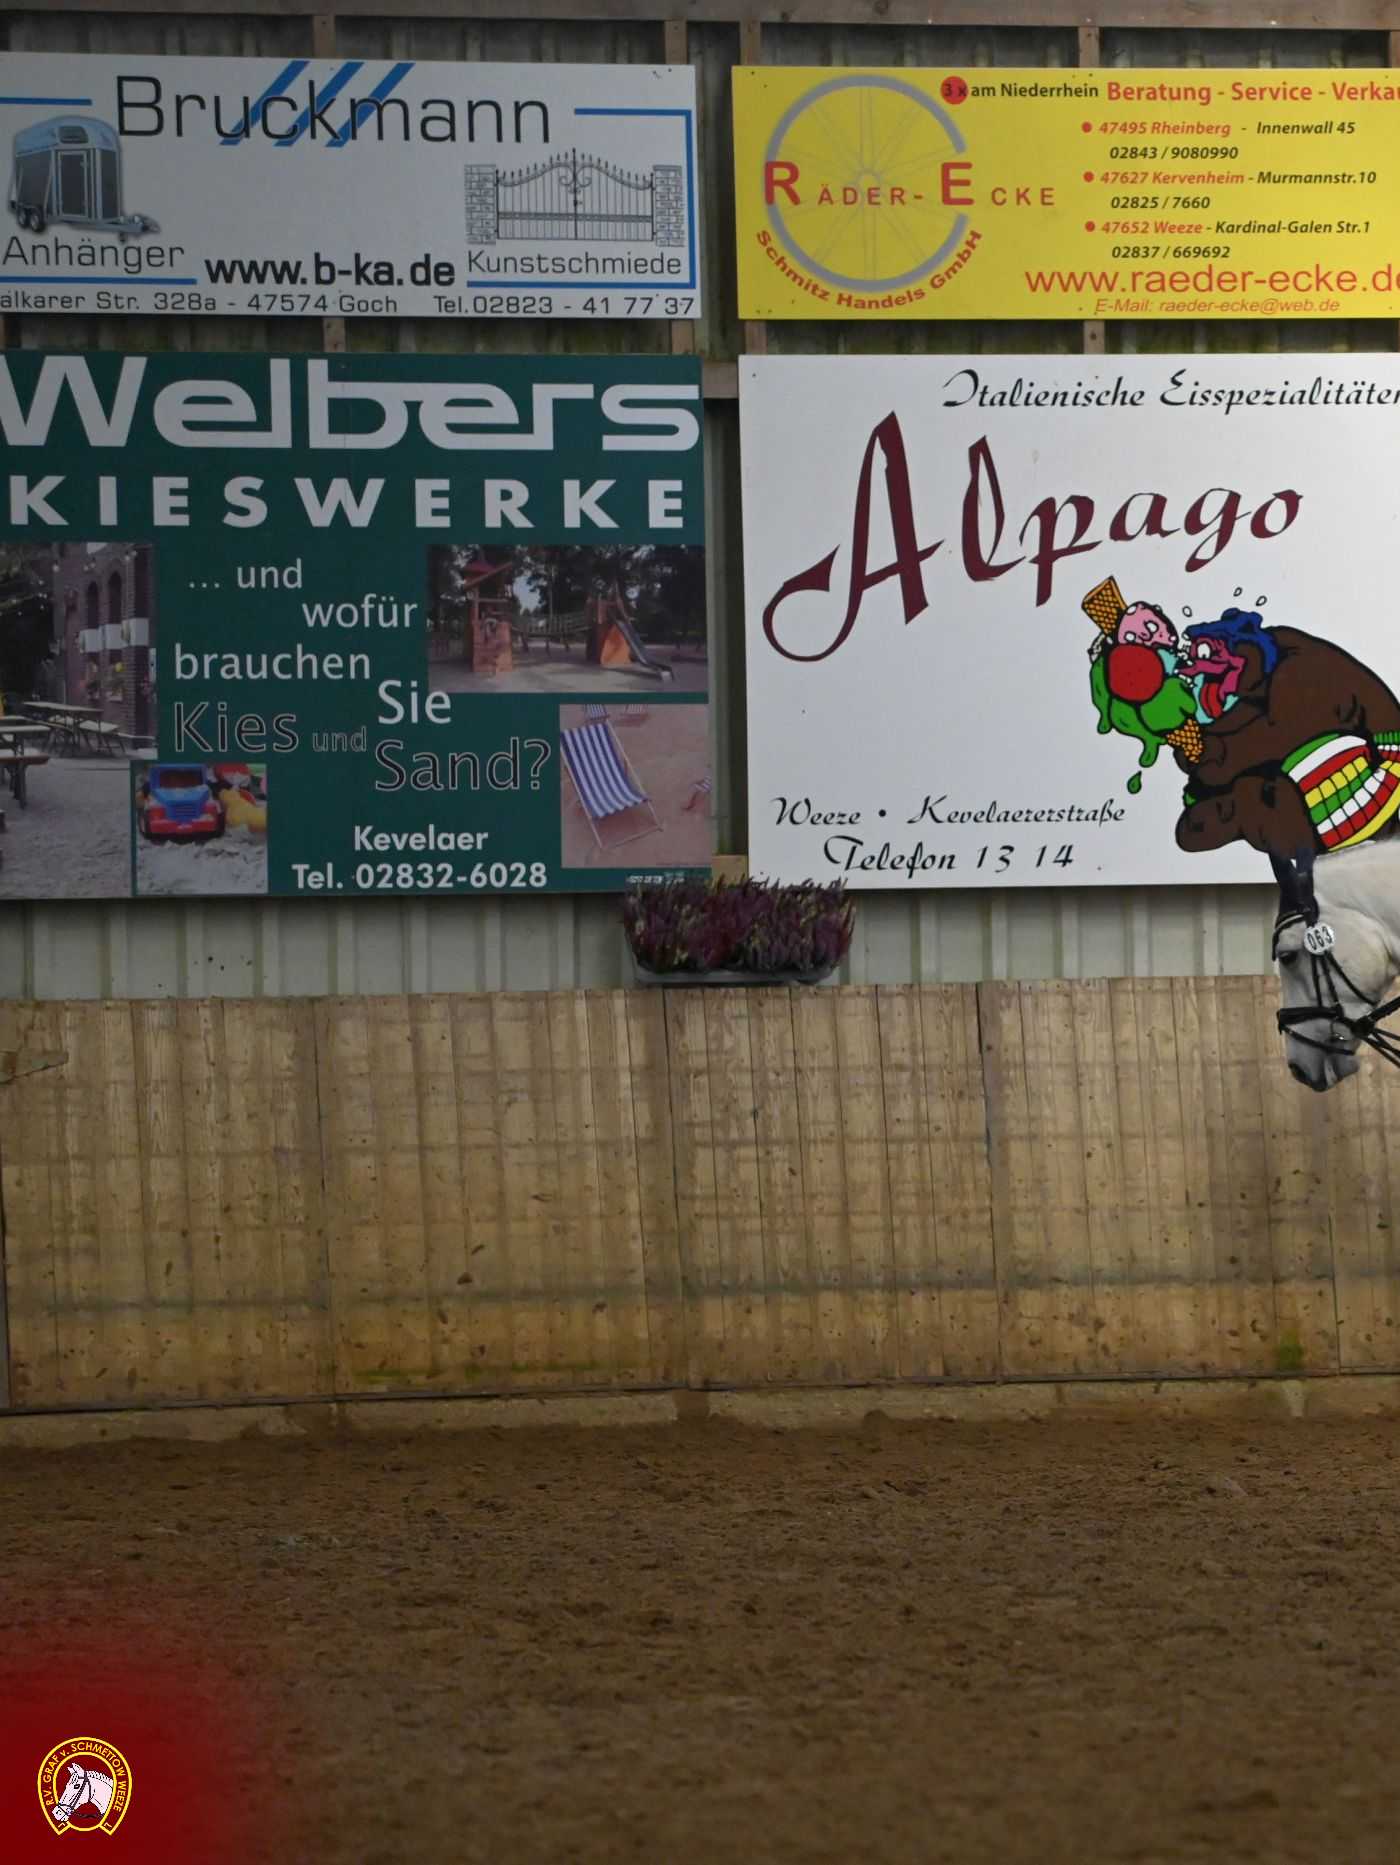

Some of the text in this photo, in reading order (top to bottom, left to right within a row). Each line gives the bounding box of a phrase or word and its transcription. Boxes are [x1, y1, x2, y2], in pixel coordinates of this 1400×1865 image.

[971, 87, 996, 98] am
[1001, 83, 1098, 98] Niederrhein
[1107, 81, 1211, 105] Beratung
[1231, 82, 1312, 100] Service
[116, 75, 550, 143] Bruckmann
[1099, 122, 1147, 134] 47495
[1151, 121, 1231, 137] Rheinberg
[1256, 121, 1332, 134] Innenwall
[1337, 122, 1355, 134] 45
[1100, 172, 1148, 184] 47627
[1152, 171, 1244, 184] Kervenheim
[1102, 222, 1149, 234] 47652
[1153, 222, 1202, 234] Weeze
[1216, 221, 1332, 234] Kardinal-Galen
[2, 236, 184, 274] Anhänger
[205, 251, 455, 287] www.b-ka.de
[468, 250, 682, 275] Kunstschmiede
[756, 230, 983, 309] Schmitz Handels GmbH
[96, 292, 139, 309] Str.
[154, 292, 216, 310] 328a
[247, 295, 328, 313] 47574
[339, 295, 397, 313] Goch
[583, 297, 609, 314] 41
[624, 297, 652, 314] 77
[665, 297, 694, 315] 37
[1096, 298, 1339, 315] E-Mail: raeder-ecke@web.de
[0, 355, 699, 451] Welbers
[943, 369, 1145, 408] Italienische
[9, 475, 684, 528] KIESWERKE
[762, 410, 1304, 662] Alpago
[236, 559, 303, 588] und
[302, 594, 417, 628] wofür
[175, 644, 370, 680] brauchen
[378, 679, 452, 725] Sie
[175, 703, 367, 753] Kies und
[375, 737, 550, 791] Sand?
[773, 796, 1125, 826] Weeze Kevelaererstraße
[354, 826, 489, 852] Kevelaer
[824, 836, 1073, 879] Telefon 13 14
[292, 862, 547, 889] Tel. 02832-6028
[1307, 926, 1332, 950] 063
